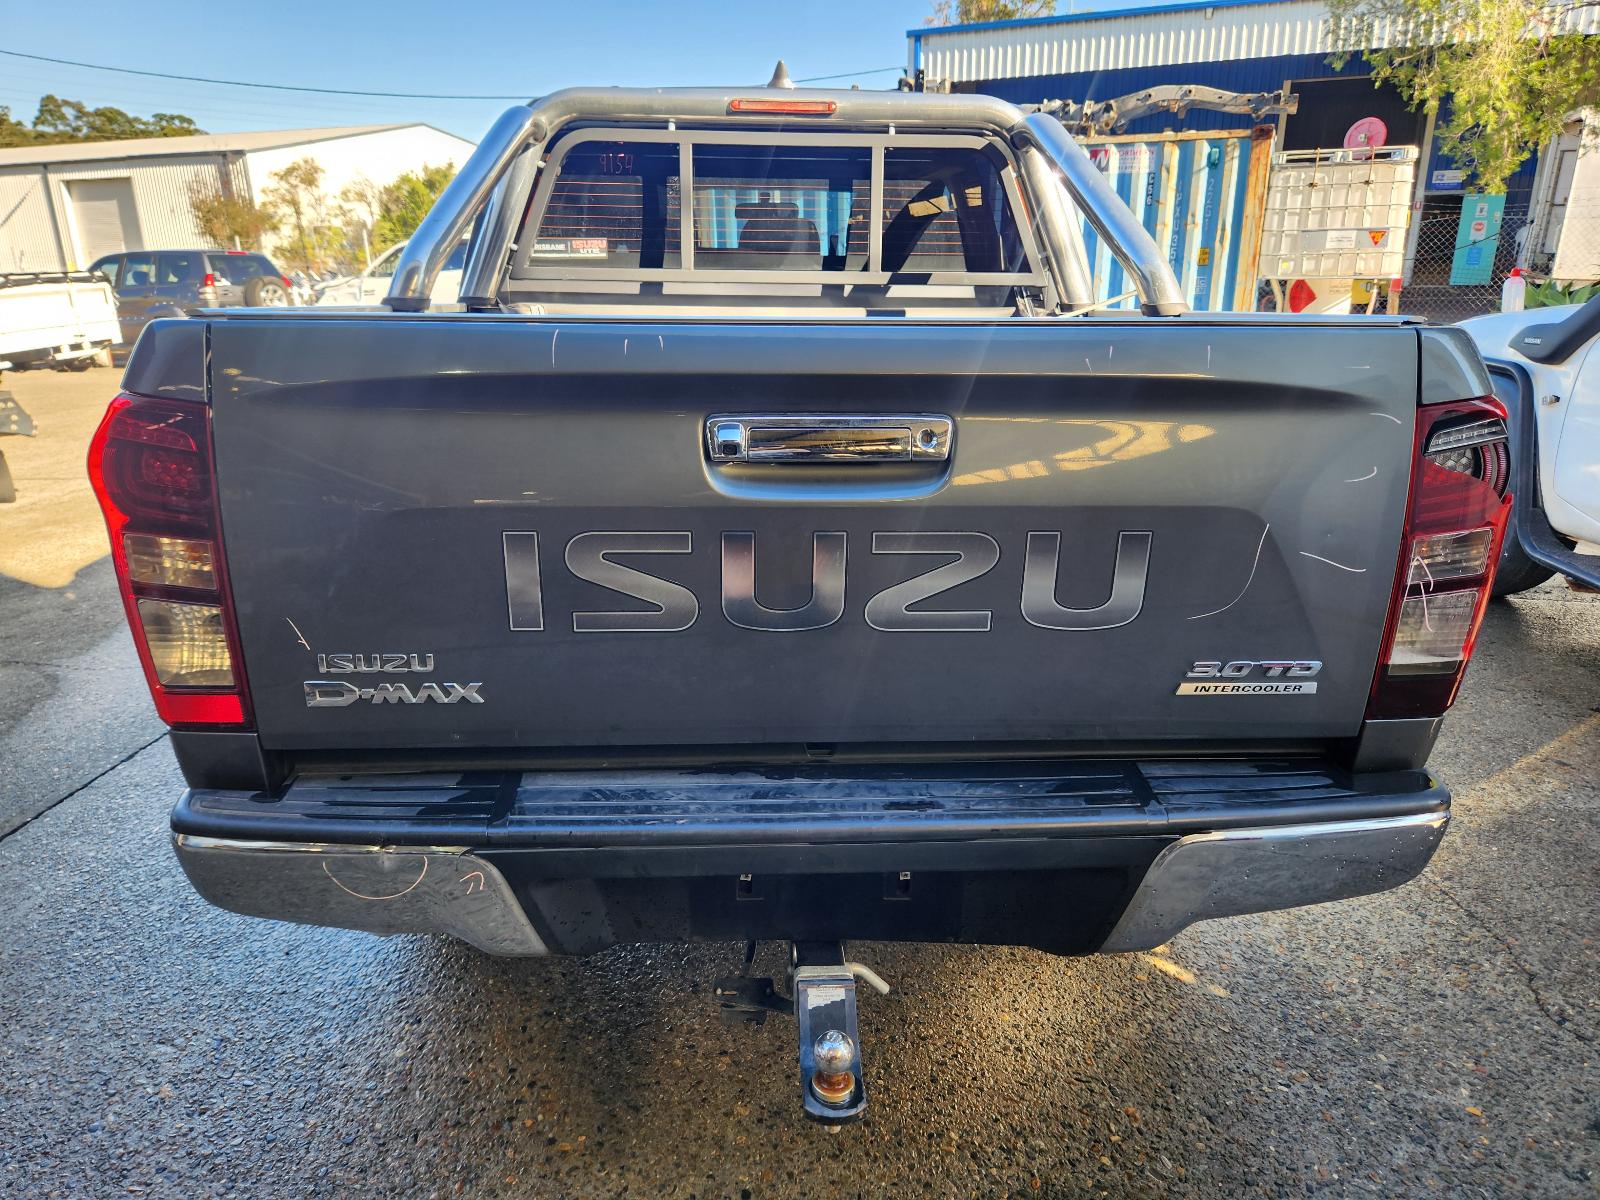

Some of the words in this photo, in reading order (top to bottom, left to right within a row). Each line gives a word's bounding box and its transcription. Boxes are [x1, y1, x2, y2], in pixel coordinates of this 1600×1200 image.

[533, 243, 566, 251] RISBANE
[572, 239, 607, 249] ISUZU
[502, 530, 1153, 633] ISUZU
[318, 653, 434, 673] ISUZU
[303, 680, 485, 707] D-MAX
[1193, 684, 1303, 693] INTERCOOLER
